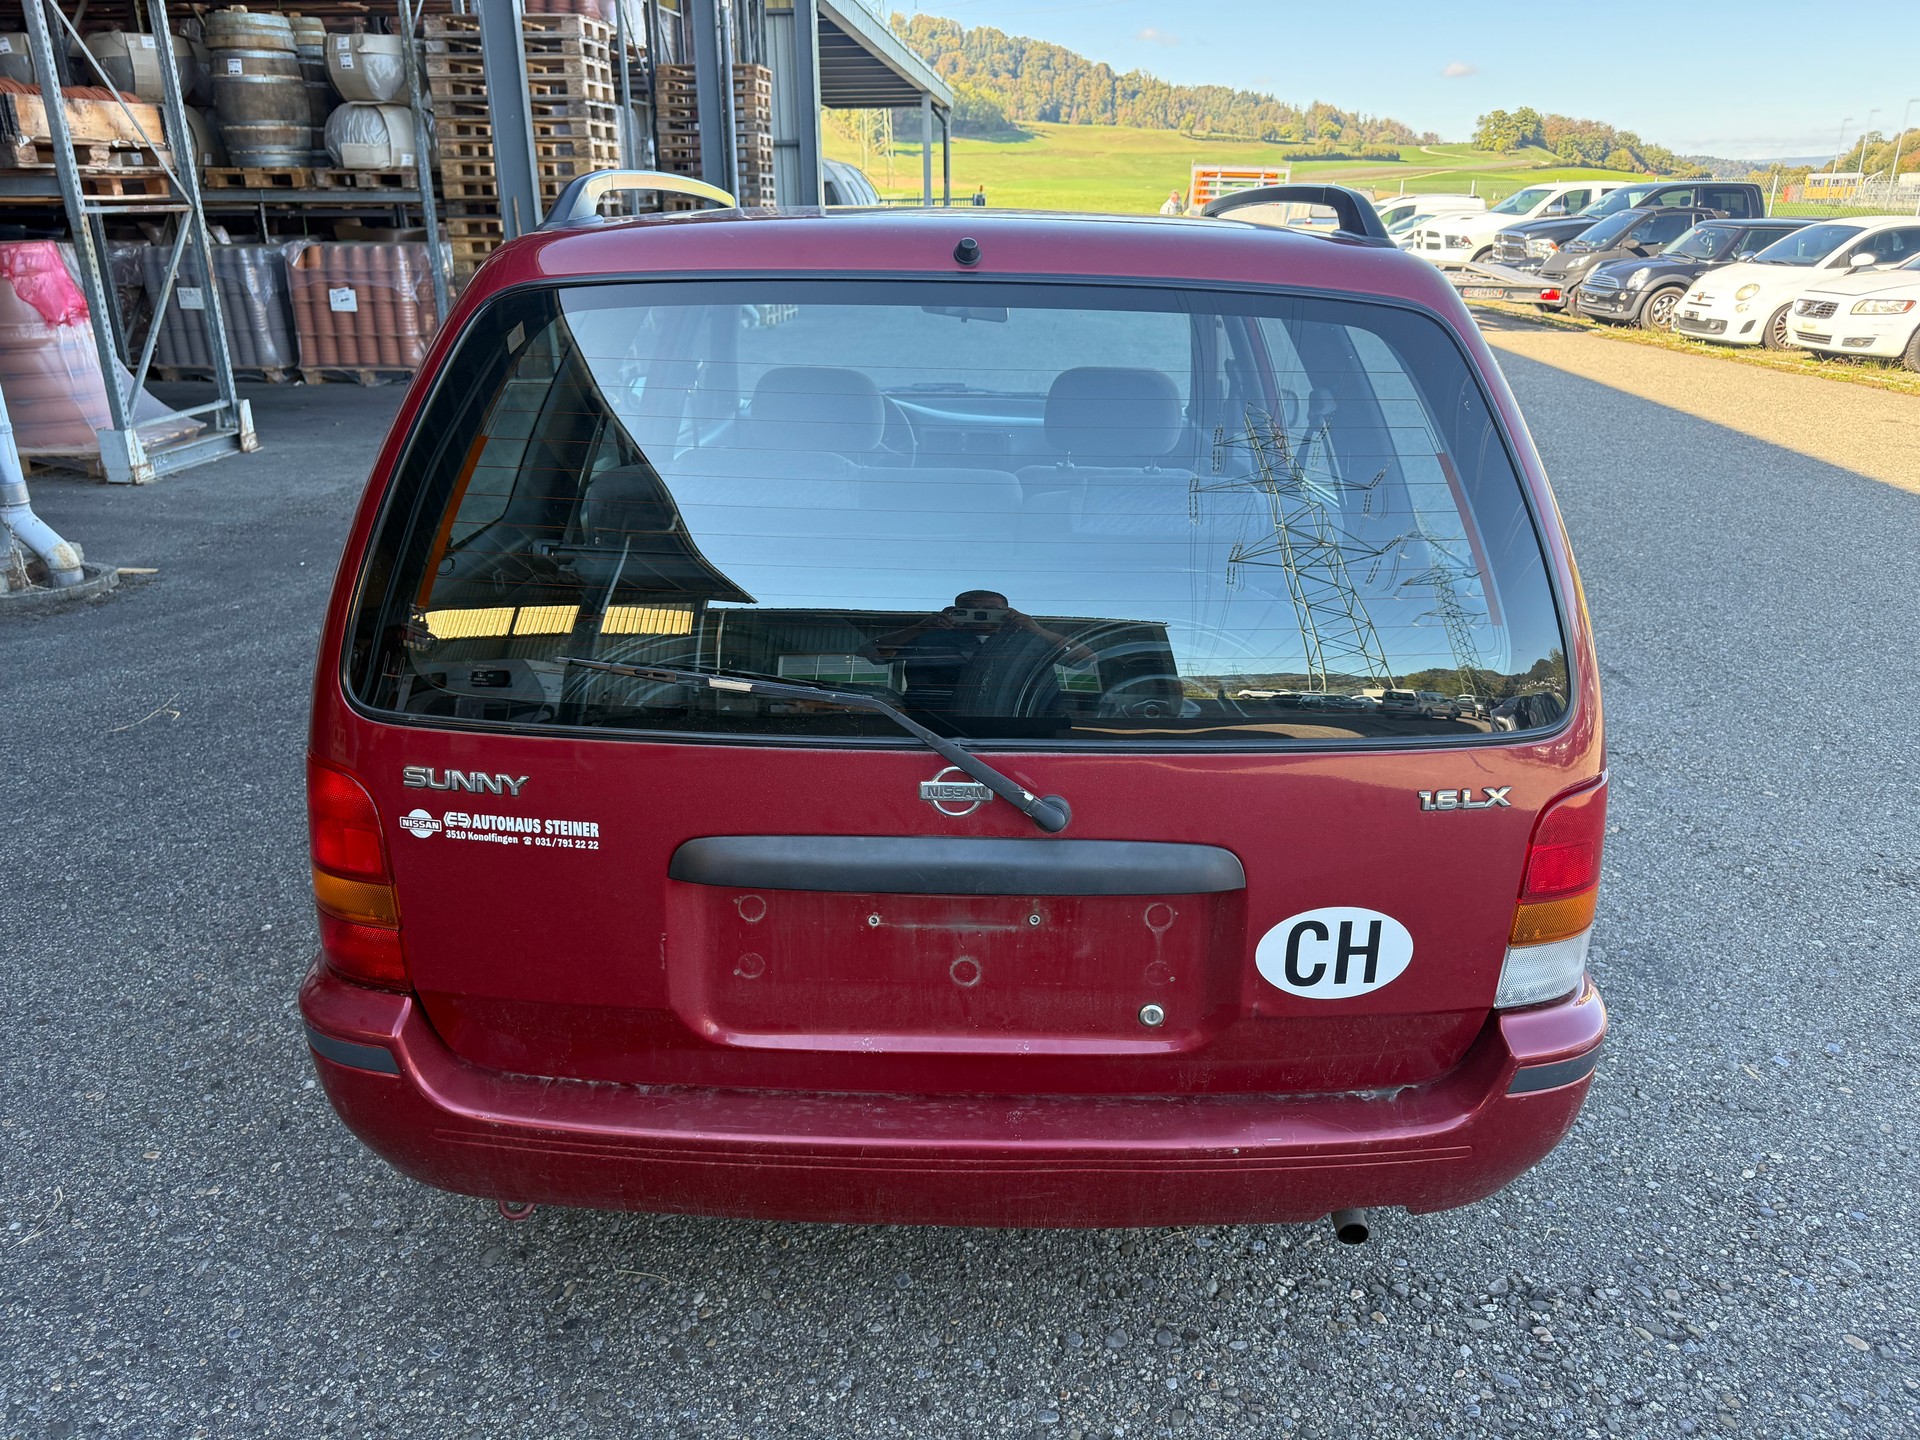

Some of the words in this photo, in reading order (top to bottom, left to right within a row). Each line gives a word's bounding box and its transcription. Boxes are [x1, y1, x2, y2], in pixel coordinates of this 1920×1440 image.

[402, 765, 530, 796] SUNNY
[926, 785, 986, 799] NISSAN
[402, 819, 439, 830] NISSAN
[472, 813, 542, 834] AUTOHAUS
[544, 819, 600, 838] STEINER
[445, 829, 467, 840] 3510
[468, 831, 519, 845] Konolfingen
[535, 836, 574, 848] 031/791
[575, 839, 587, 849] 22
[587, 840, 599, 850] 22
[1284, 919, 1383, 988] CH
